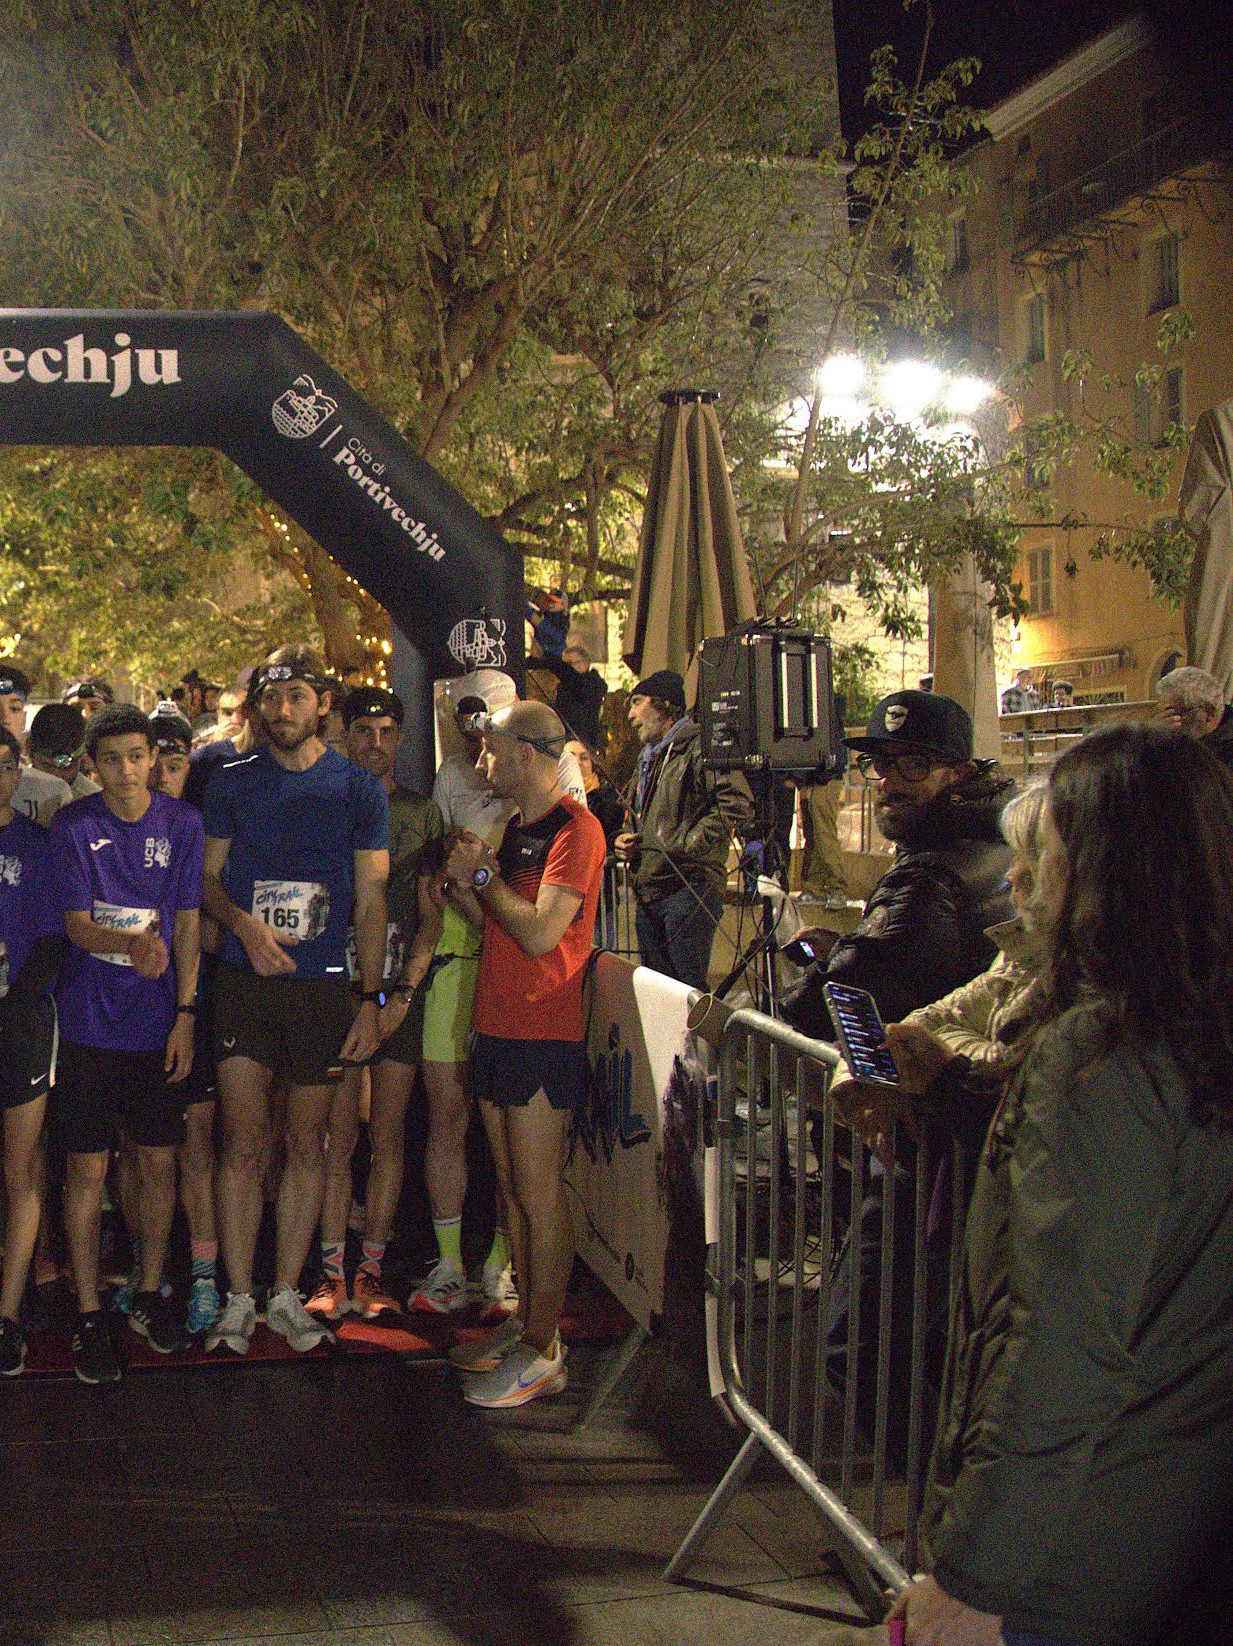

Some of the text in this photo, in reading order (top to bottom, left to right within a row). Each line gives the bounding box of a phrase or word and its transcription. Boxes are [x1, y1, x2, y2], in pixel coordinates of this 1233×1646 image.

[371, 462, 385, 476] di
[332, 446, 446, 562] Portivechju
[144, 837, 155, 868] UCB
[261, 907, 300, 929] 165
